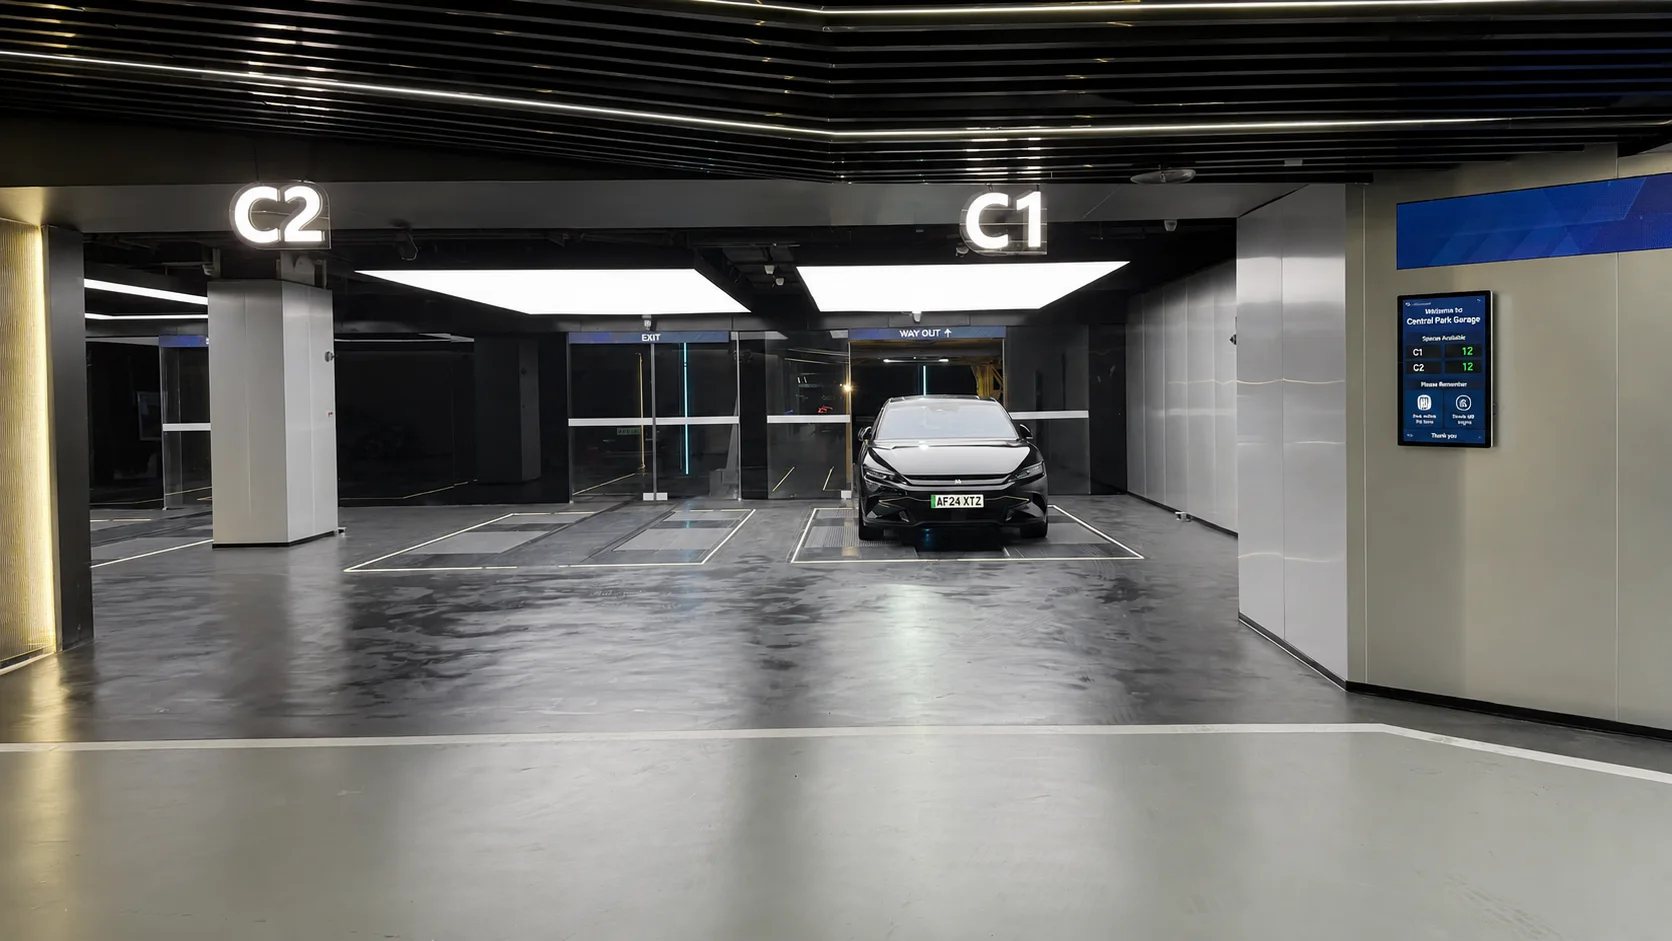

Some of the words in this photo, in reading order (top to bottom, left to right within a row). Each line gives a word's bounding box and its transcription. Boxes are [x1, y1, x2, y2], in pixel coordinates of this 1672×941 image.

[234, 185, 324, 244] C2
[966, 191, 1042, 249] C1
[1406, 317, 1434, 325] Central
[1435, 316, 1452, 324] Park
[1453, 316, 1481, 325] Garage
[641, 333, 661, 342] EXIT
[899, 329, 920, 338] WAY
[921, 329, 941, 337] OUT
[1412, 348, 1423, 356] C1
[1462, 346, 1473, 356] 12
[1413, 363, 1425, 372] C2
[1462, 362, 1474, 372] 12
[936, 496, 960, 507] AF24
[963, 496, 982, 506] XTZ
